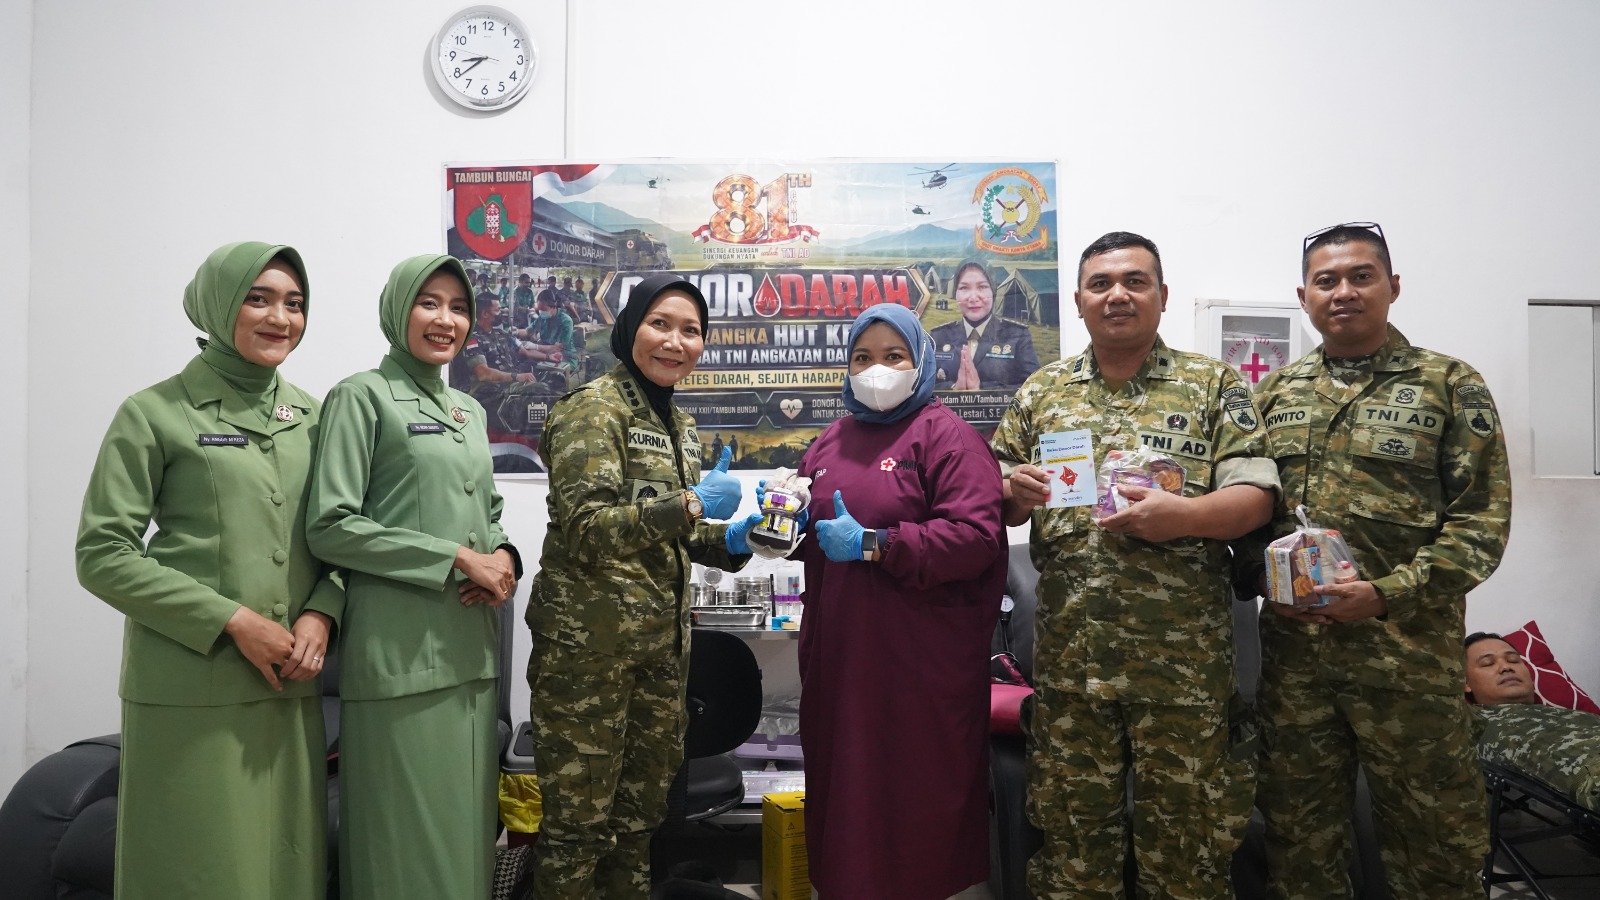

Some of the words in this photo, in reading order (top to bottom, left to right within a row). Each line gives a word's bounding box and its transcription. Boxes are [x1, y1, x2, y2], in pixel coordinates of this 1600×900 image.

[467, 25, 477, 34] 11
[483, 21, 494, 31] 12
[502, 27, 507, 36] 1
[454, 35, 467, 45] 10
[513, 39, 520, 48] 2
[449, 50, 457, 61] 9
[516, 54, 524, 65] 3
[453, 67, 461, 79] 8
[509, 70, 517, 81] 4
[465, 78, 472, 89] 7
[497, 82, 505, 92] 5
[481, 85, 489, 95] 6
[455, 172, 494, 183] TAMBUN
[496, 171, 532, 182] BUNGAI
[709, 173, 789, 242] 81
[550, 240, 581, 255] DONOR
[582, 246, 605, 259] DARAH
[781, 247, 796, 259] TNI
[618, 274, 753, 317] DOR
[776, 273, 911, 317] DARAH
[773, 324, 818, 347] HUT
[1226, 337, 1247, 364] FIRST
[1254, 336, 1270, 346] AID
[724, 349, 747, 364] TNI
[750, 348, 822, 364] ANGKATAN
[713, 374, 754, 386] DARAH,
[758, 373, 798, 384] SEJUTA
[802, 372, 845, 384] HARAPA
[812, 398, 835, 408] DONOR
[836, 398, 845, 408] DA
[937, 395, 959, 404] udam
[960, 394, 1002, 404] XXII/Tambun
[698, 406, 736, 414] XXII/TAMBUN
[736, 406, 758, 414] BUNGAI
[812, 409, 835, 418] UNTUK
[959, 408, 987, 418] Lestari,
[1366, 408, 1400, 421] TNI
[1406, 413, 1437, 429] AD
[628, 432, 668, 450] KURNIA
[1141, 434, 1173, 450] TNI
[1180, 440, 1207, 456] AD
